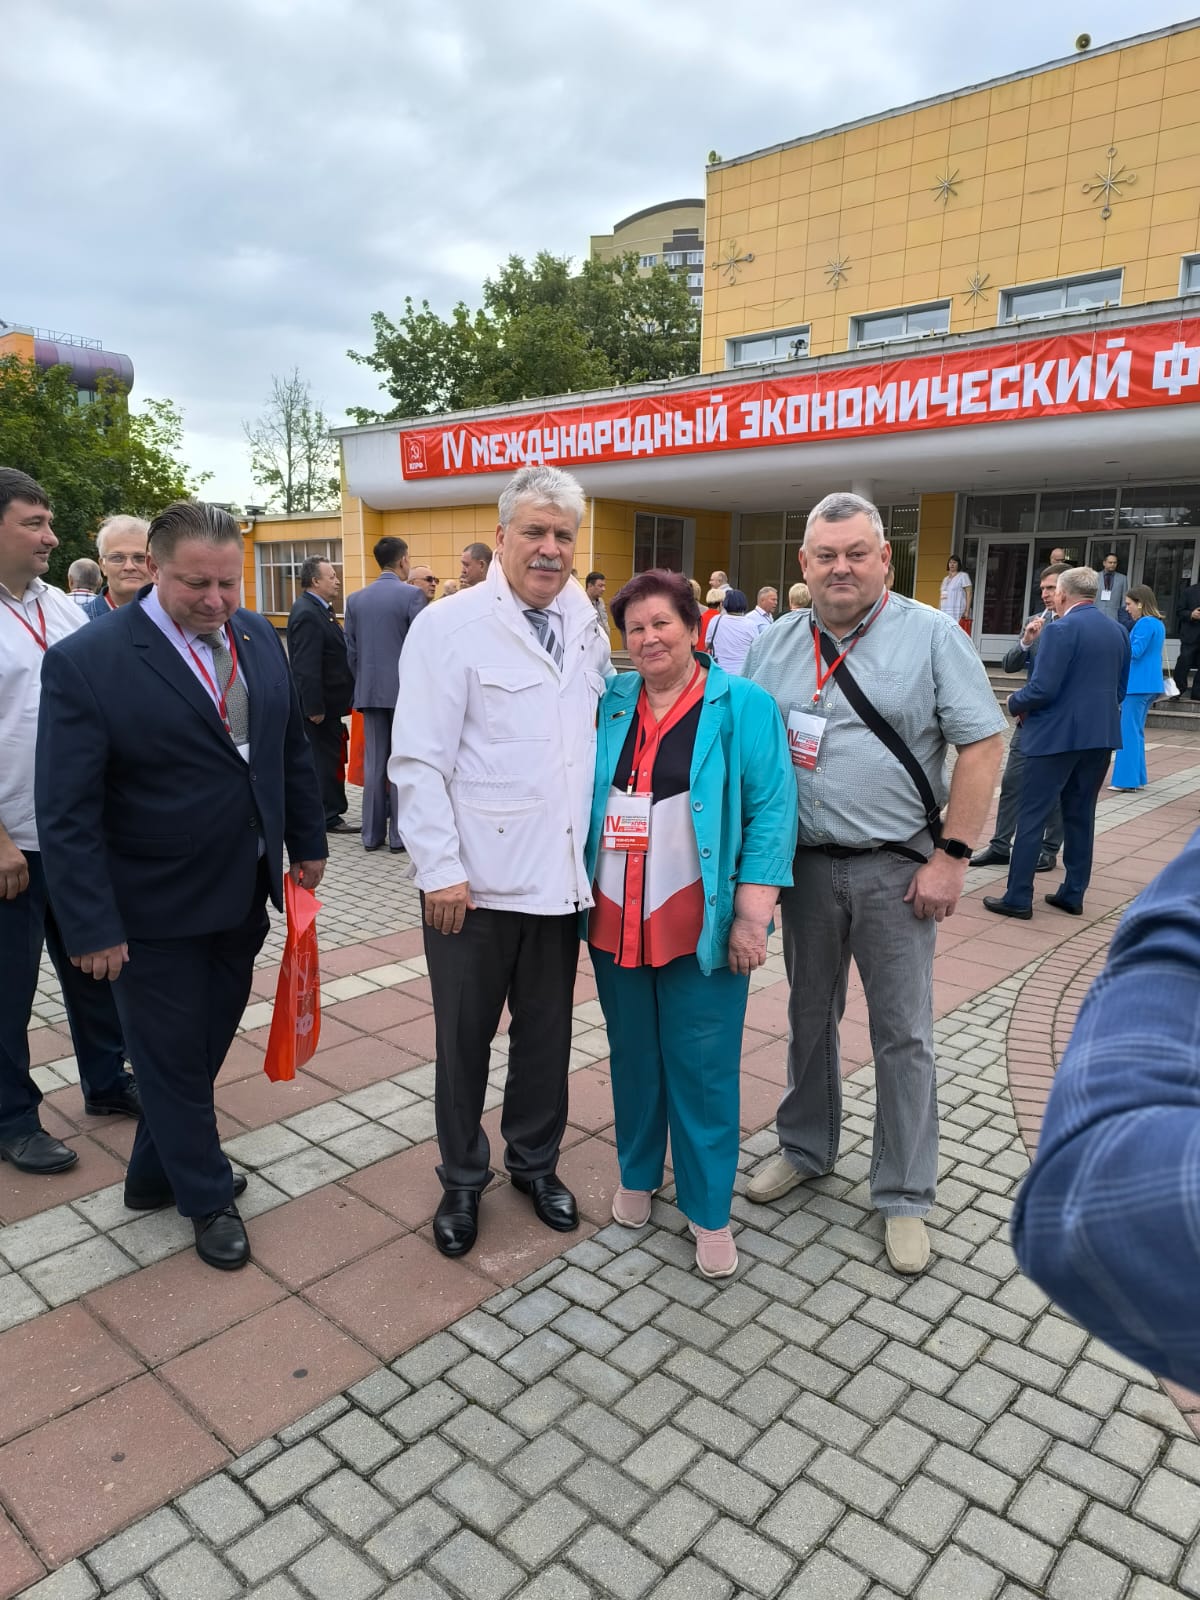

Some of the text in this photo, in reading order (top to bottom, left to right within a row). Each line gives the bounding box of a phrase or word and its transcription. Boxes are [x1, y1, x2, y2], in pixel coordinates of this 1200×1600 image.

[442, 337, 1200, 470] IV МЕЖДУНАРОДНЫЙ ЭКОНОМИЧЕСКИЙ Ф
[606, 815, 621, 832] IV
